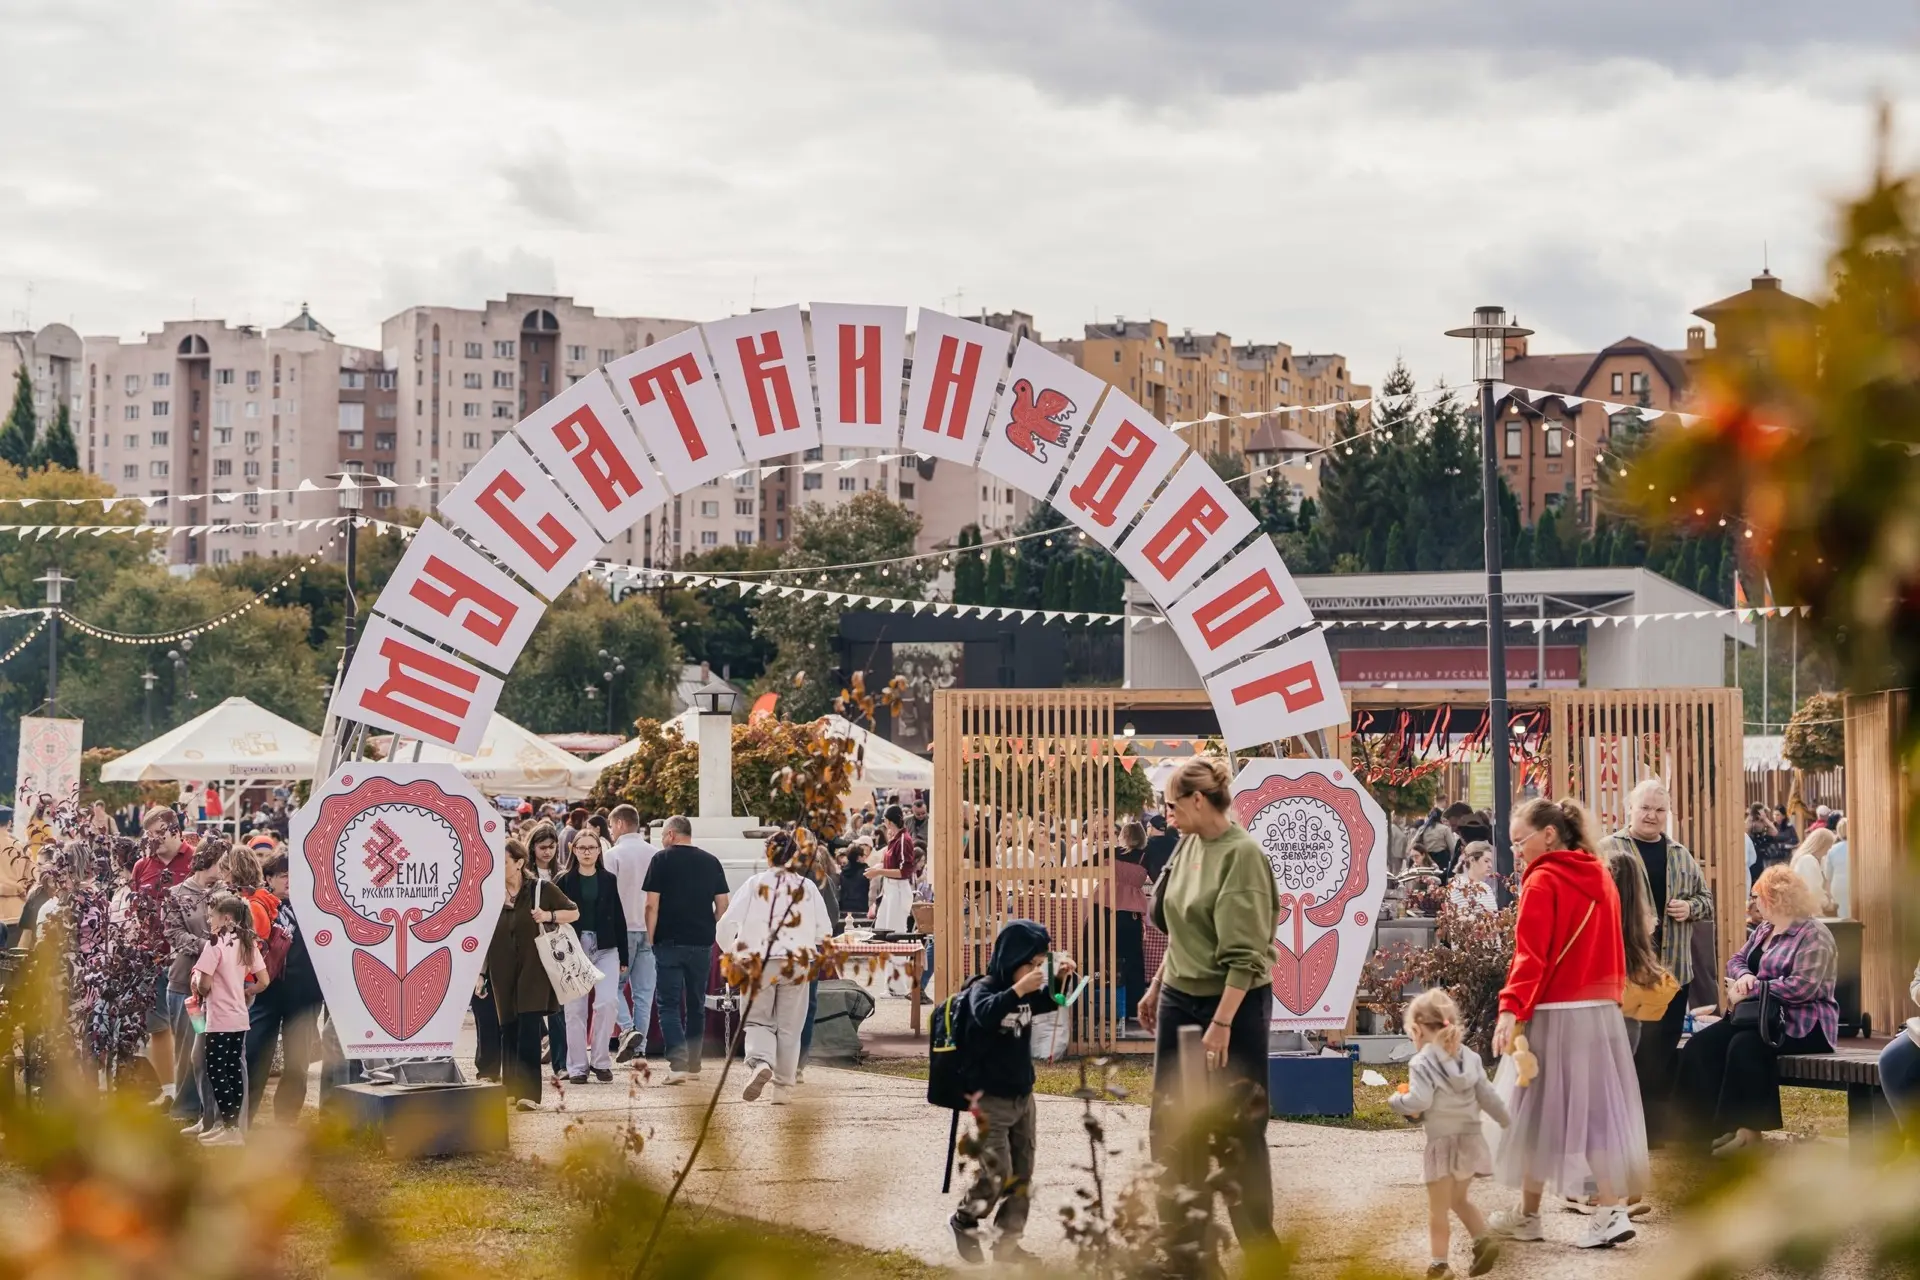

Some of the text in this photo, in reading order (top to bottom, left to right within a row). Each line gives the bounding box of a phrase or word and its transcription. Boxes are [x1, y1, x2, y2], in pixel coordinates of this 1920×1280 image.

[359, 325, 1324, 744] МУСАТКИН ДВОР
[1358, 670, 1430, 680] ФЕСТИВАЛЬ
[1436, 669, 1489, 679] РУССКИ
[1280, 850, 1318, 860] ЗЕМЛЯ
[361, 884, 439, 899] РУССКИХ ТРАДИЦИЙ
